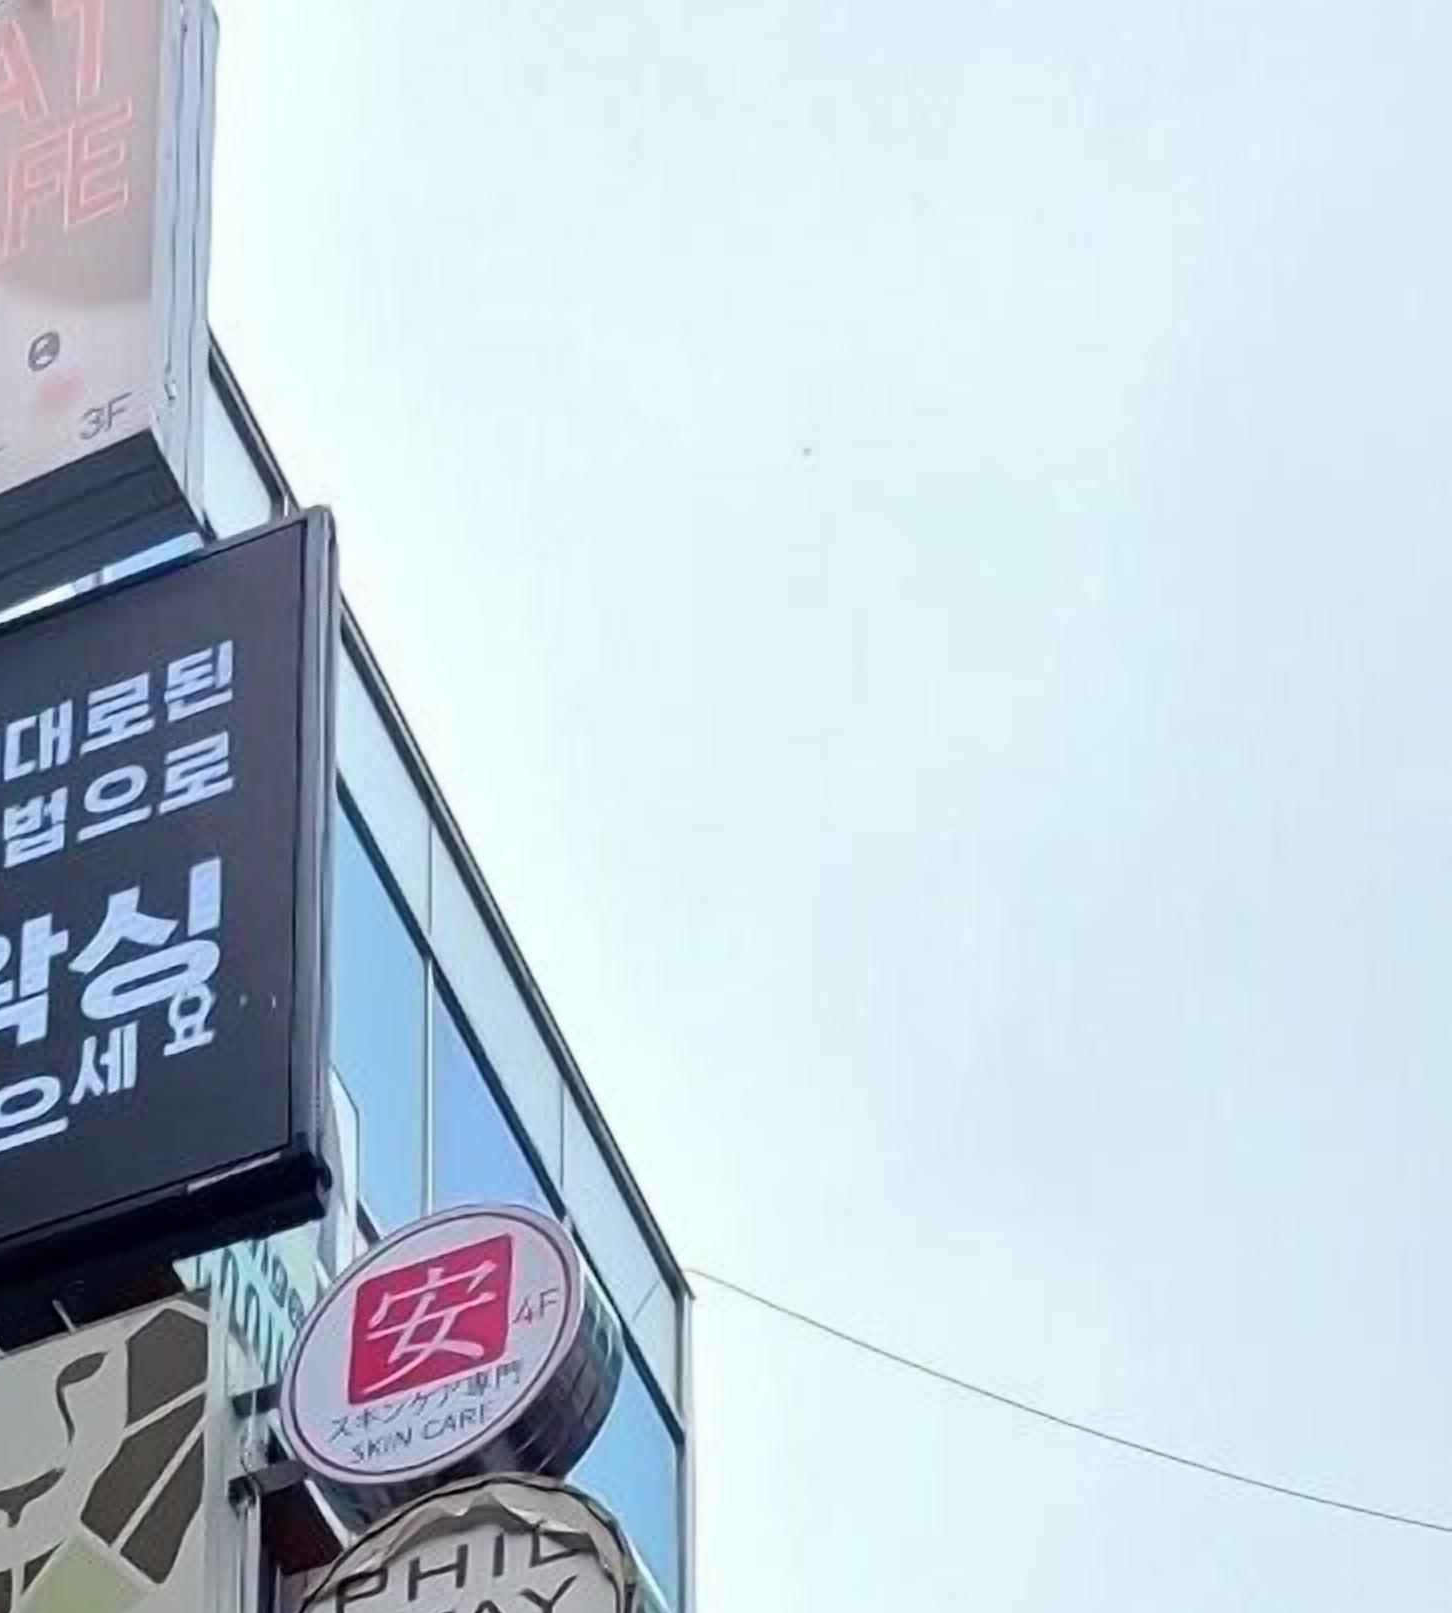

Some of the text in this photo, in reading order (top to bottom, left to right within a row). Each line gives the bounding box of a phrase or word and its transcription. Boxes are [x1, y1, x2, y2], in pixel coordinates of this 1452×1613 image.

[81, 391, 132, 439] 3F
[365, 1260, 497, 1396] 安
[351, 1403, 491, 1466] SKIN CARE
